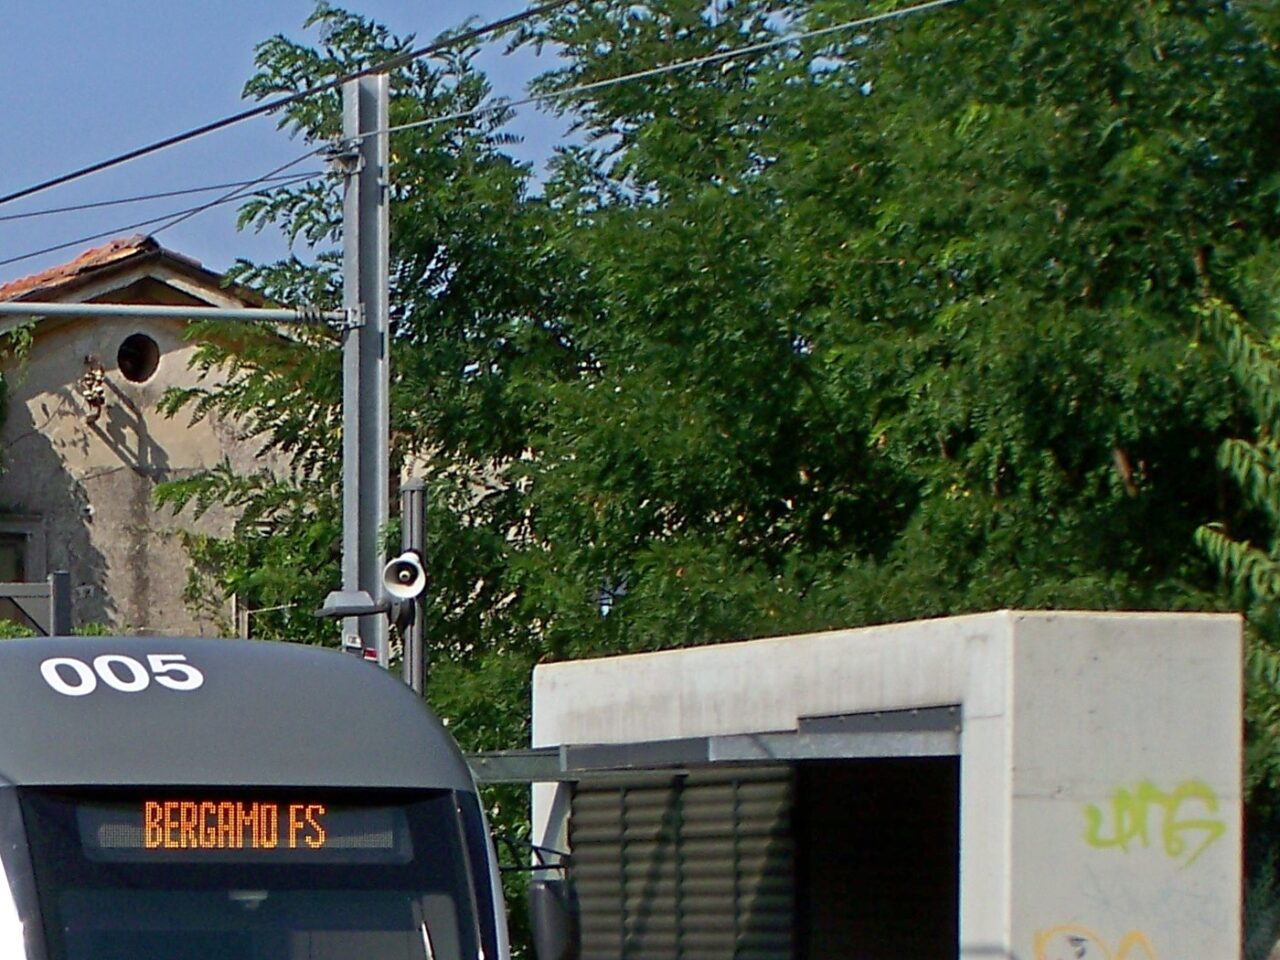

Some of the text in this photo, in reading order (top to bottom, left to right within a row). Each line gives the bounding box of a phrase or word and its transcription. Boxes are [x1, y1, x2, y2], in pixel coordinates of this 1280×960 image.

[40, 654, 204, 697] 005
[145, 801, 325, 849] BERGAMO FS
